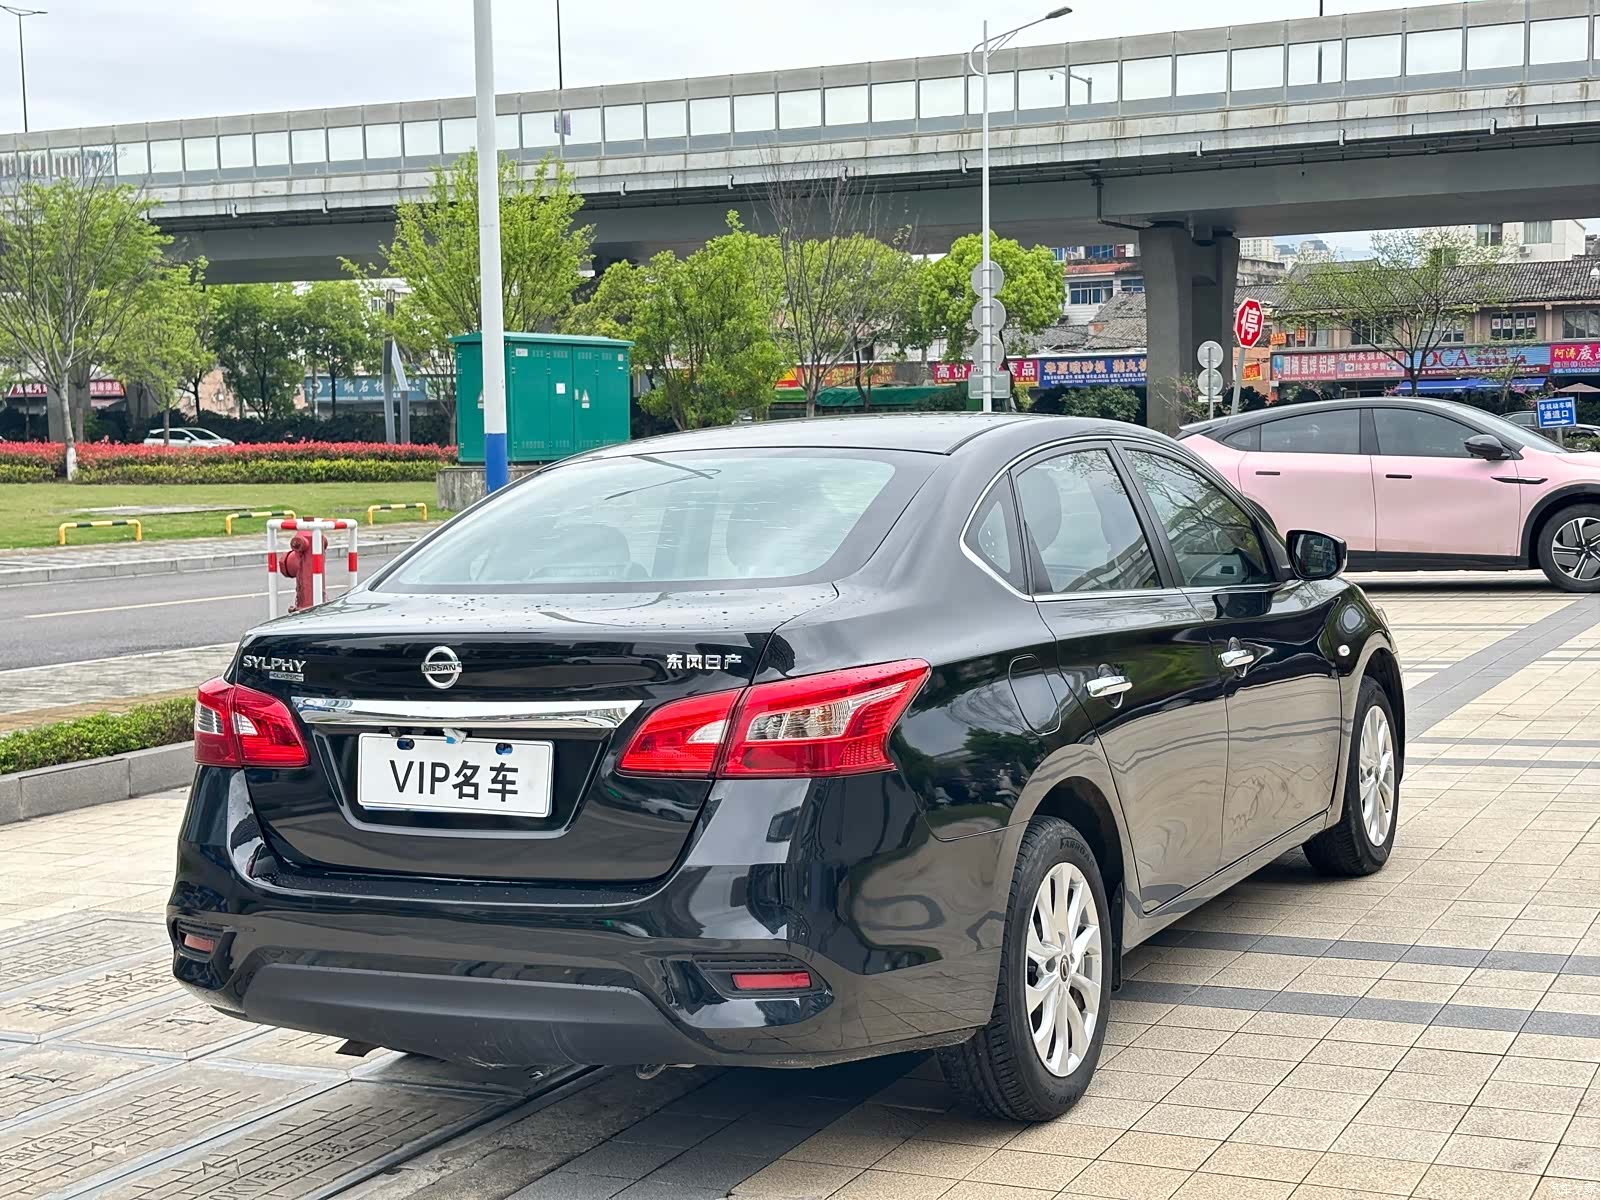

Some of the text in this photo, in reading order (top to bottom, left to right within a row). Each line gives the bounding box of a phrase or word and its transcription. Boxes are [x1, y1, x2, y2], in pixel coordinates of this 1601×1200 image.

[1241, 306, 1260, 340] 停
[1423, 348, 1470, 366] DCA
[937, 362, 1034, 378] 高价废品
[1540, 402, 1572, 411] 非机动车辆
[1544, 410, 1569, 419] 通道口
[243, 655, 306, 672] SYLPHY
[424, 664, 456, 672] NISSAN
[667, 654, 742, 669] 东风日产
[389, 760, 518, 802] VIP名车
